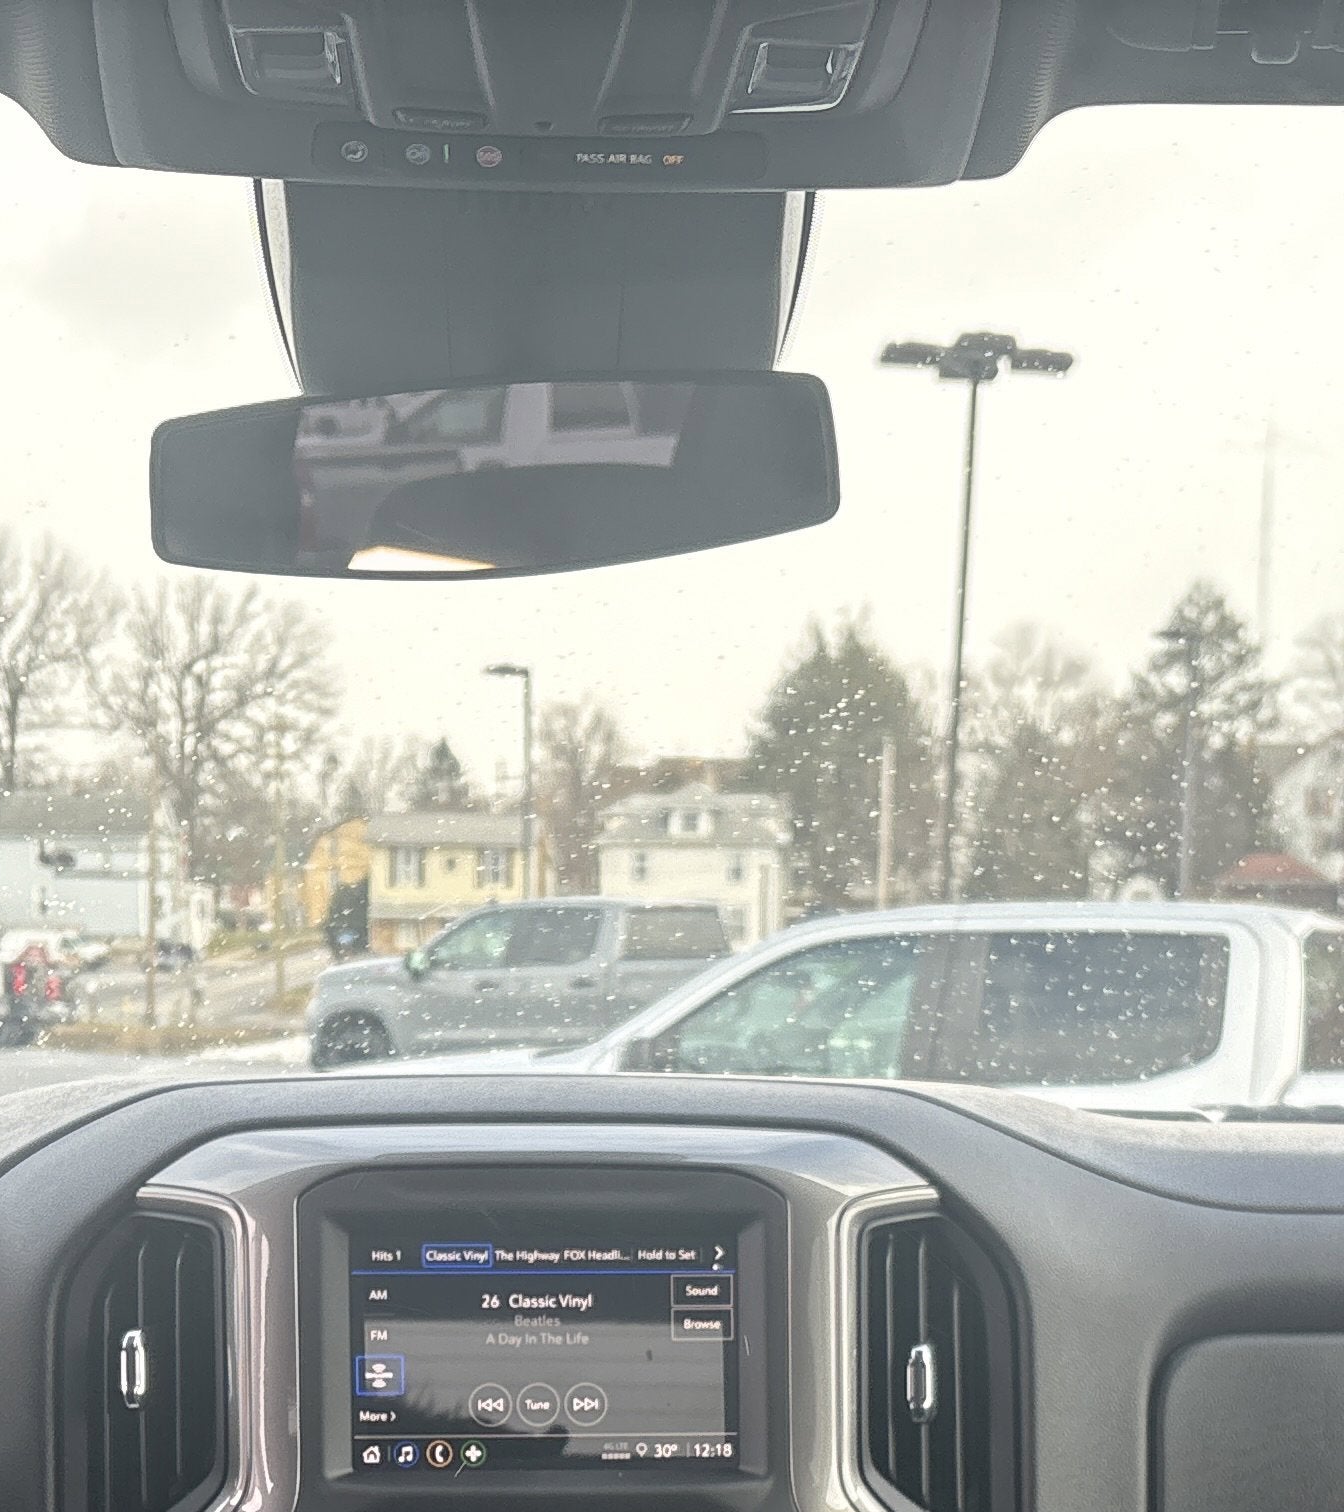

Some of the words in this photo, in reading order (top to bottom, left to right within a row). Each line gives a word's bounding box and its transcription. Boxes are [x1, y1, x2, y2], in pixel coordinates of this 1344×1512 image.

[576, 153, 605, 164] PASS
[607, 153, 627, 164] AIR
[630, 154, 653, 165] BAG
[662, 154, 685, 166] OFF
[371, 1250, 393, 1262] Hits
[425, 1250, 462, 1262] Classic
[463, 1250, 488, 1264] Vinyl
[494, 1250, 514, 1261] The
[515, 1250, 560, 1264] Highway
[563, 1249, 586, 1261] FOX
[637, 1249, 663, 1261] Hold
[664, 1250, 676, 1261] to
[678, 1249, 697, 1261] Set
[368, 1289, 388, 1301] AM
[685, 1284, 719, 1297] Sound
[481, 1294, 501, 1309] 26
[508, 1293, 556, 1309] Classic
[558, 1293, 594, 1312] Vinyl
[514, 1314, 561, 1327] Beatles
[683, 1318, 722, 1331] Browse
[370, 1330, 388, 1342] FM
[485, 1333, 497, 1345] A
[498, 1333, 522, 1348] Day
[525, 1333, 537, 1345] In
[540, 1332, 562, 1345] The
[565, 1331, 590, 1345] Life
[524, 1399, 550, 1411] Tune
[359, 1410, 388, 1422] More
[693, 1442, 733, 1458] 12:18
